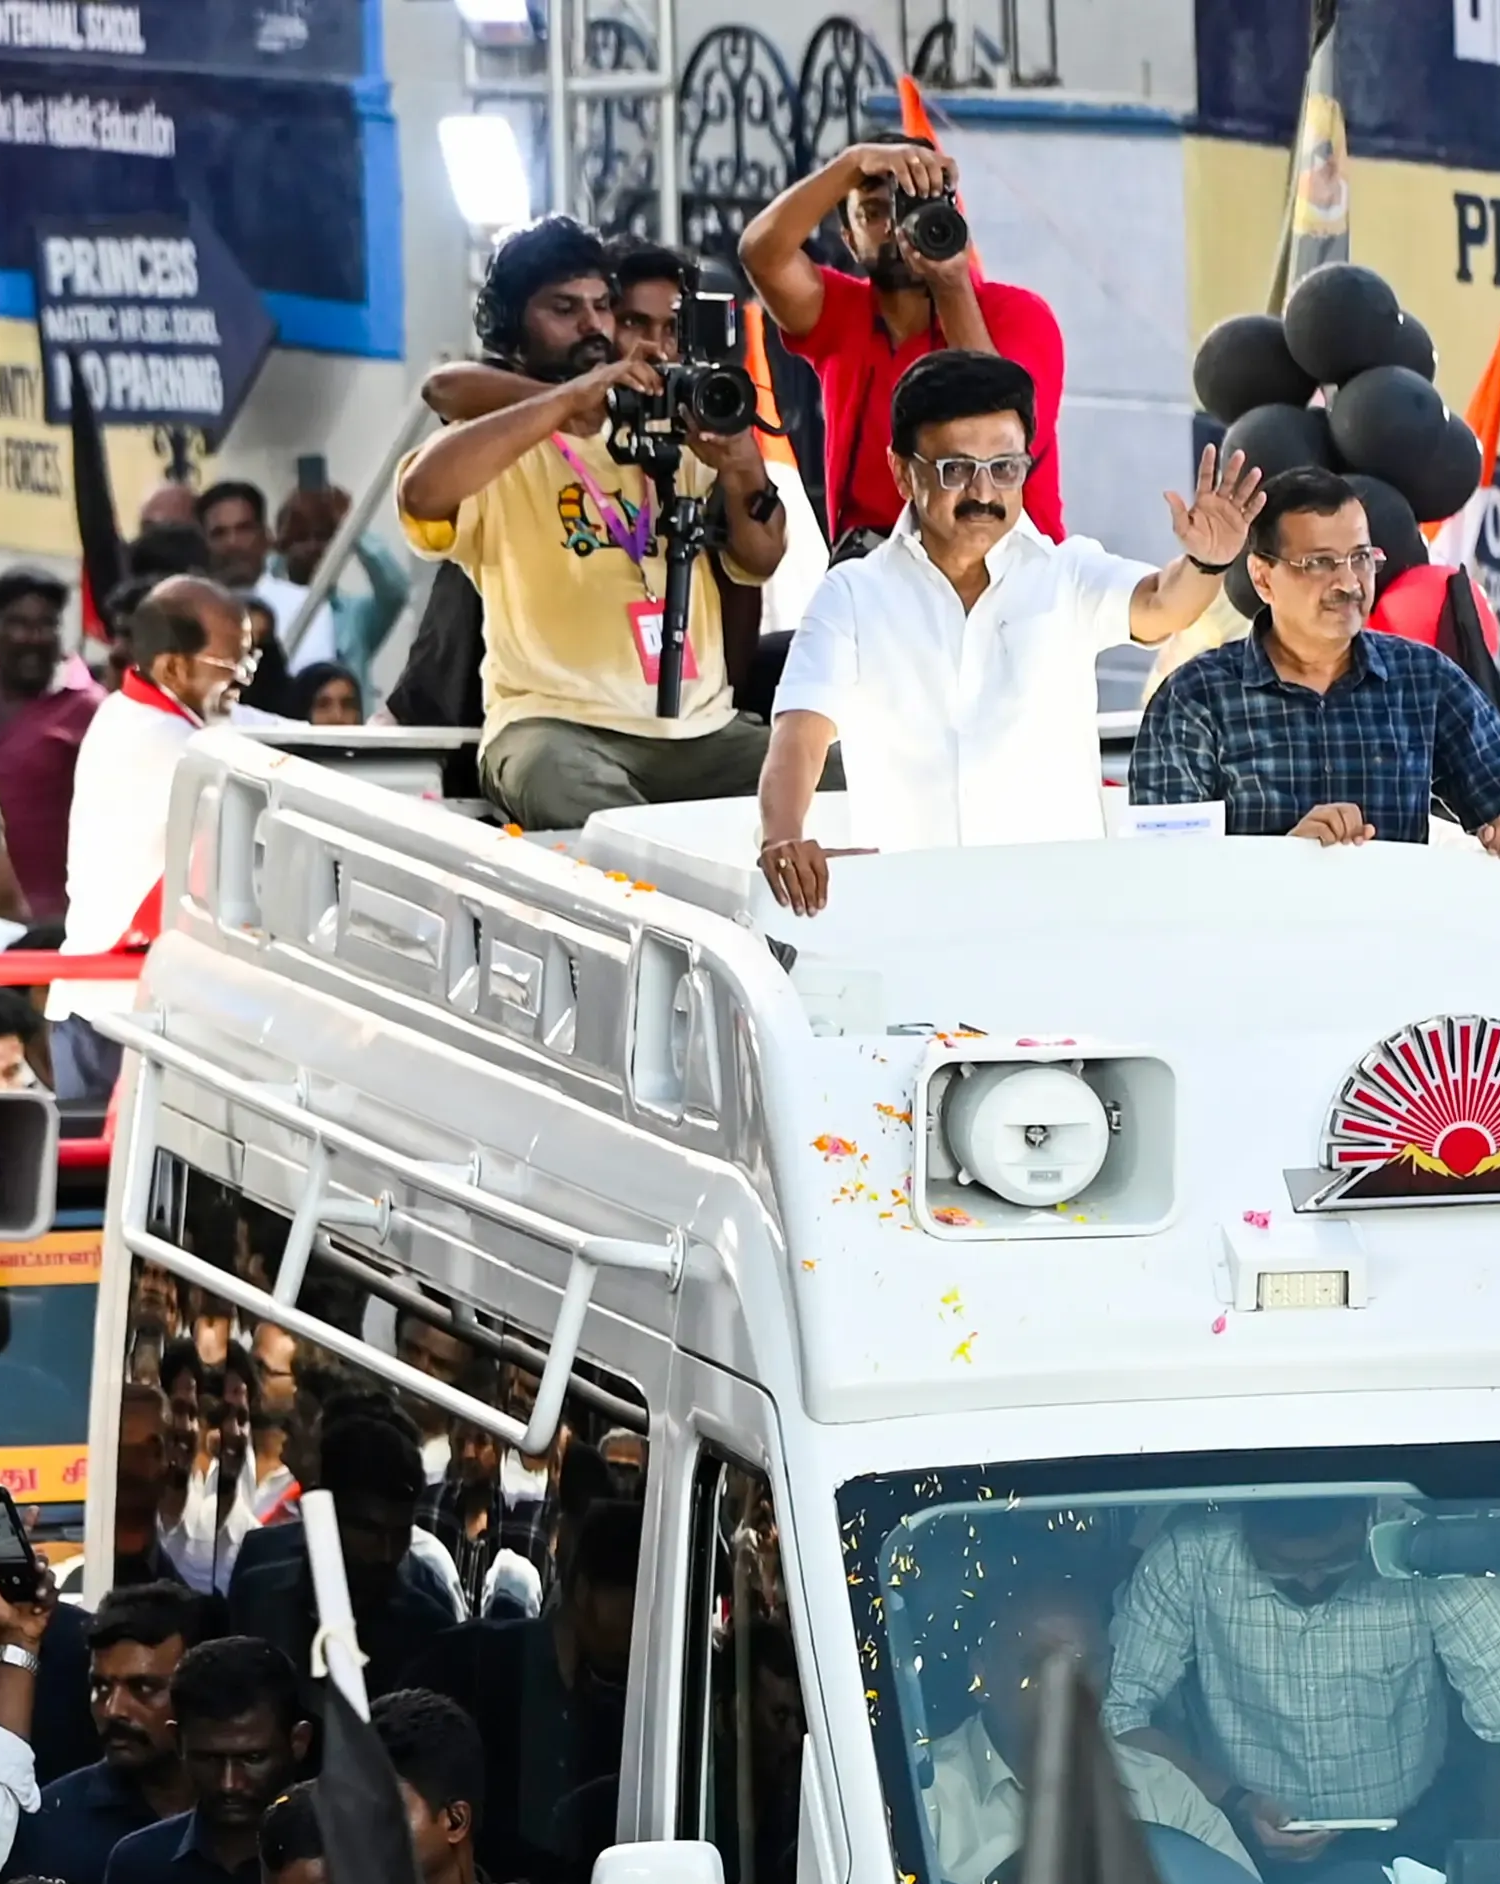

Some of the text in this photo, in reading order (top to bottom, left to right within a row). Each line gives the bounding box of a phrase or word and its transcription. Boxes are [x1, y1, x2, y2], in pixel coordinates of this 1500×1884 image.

[43, 234, 198, 299] PRINCESS
[107, 350, 224, 416] PARKING
[5, 433, 64, 498] FORCES
